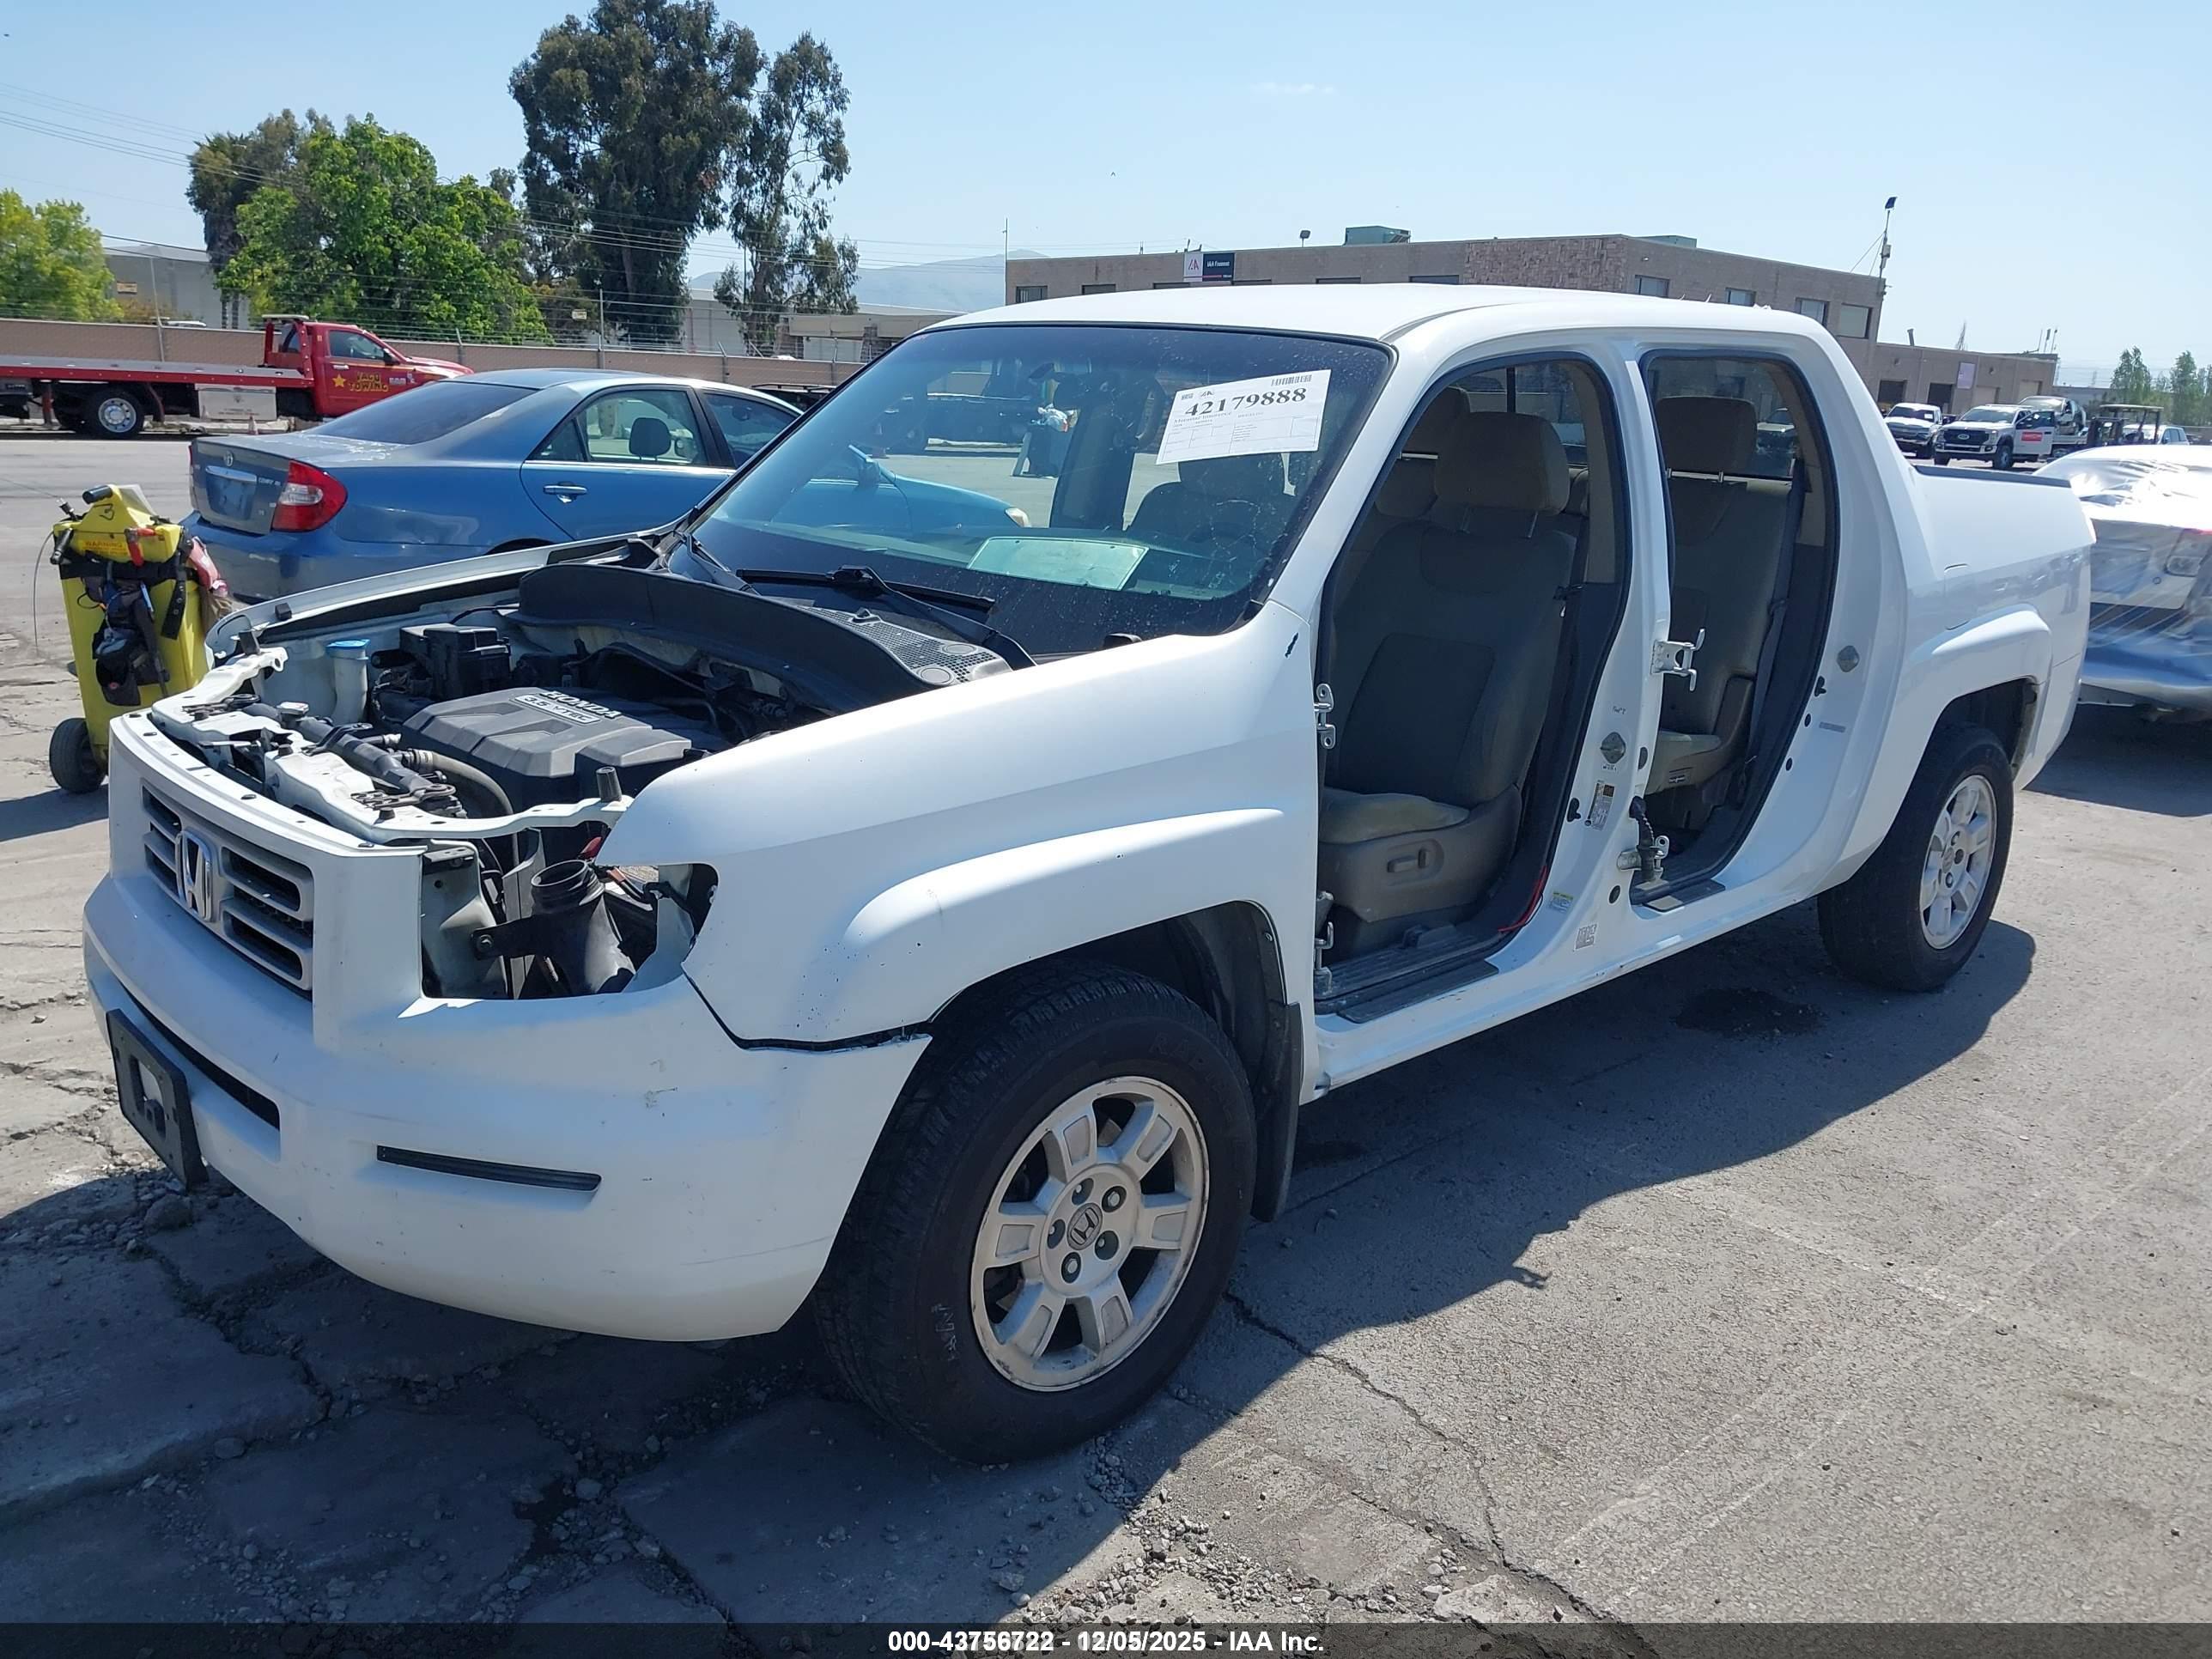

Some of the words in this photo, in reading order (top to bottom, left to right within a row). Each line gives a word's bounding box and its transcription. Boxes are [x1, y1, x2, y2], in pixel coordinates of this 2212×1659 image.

[348, 382, 389, 392] TOWING
[1185, 387, 1307, 416] 42179888
[524, 696, 550, 708] 3.5
[552, 704, 592, 722] VTEC
[539, 690, 623, 719] HONDA
